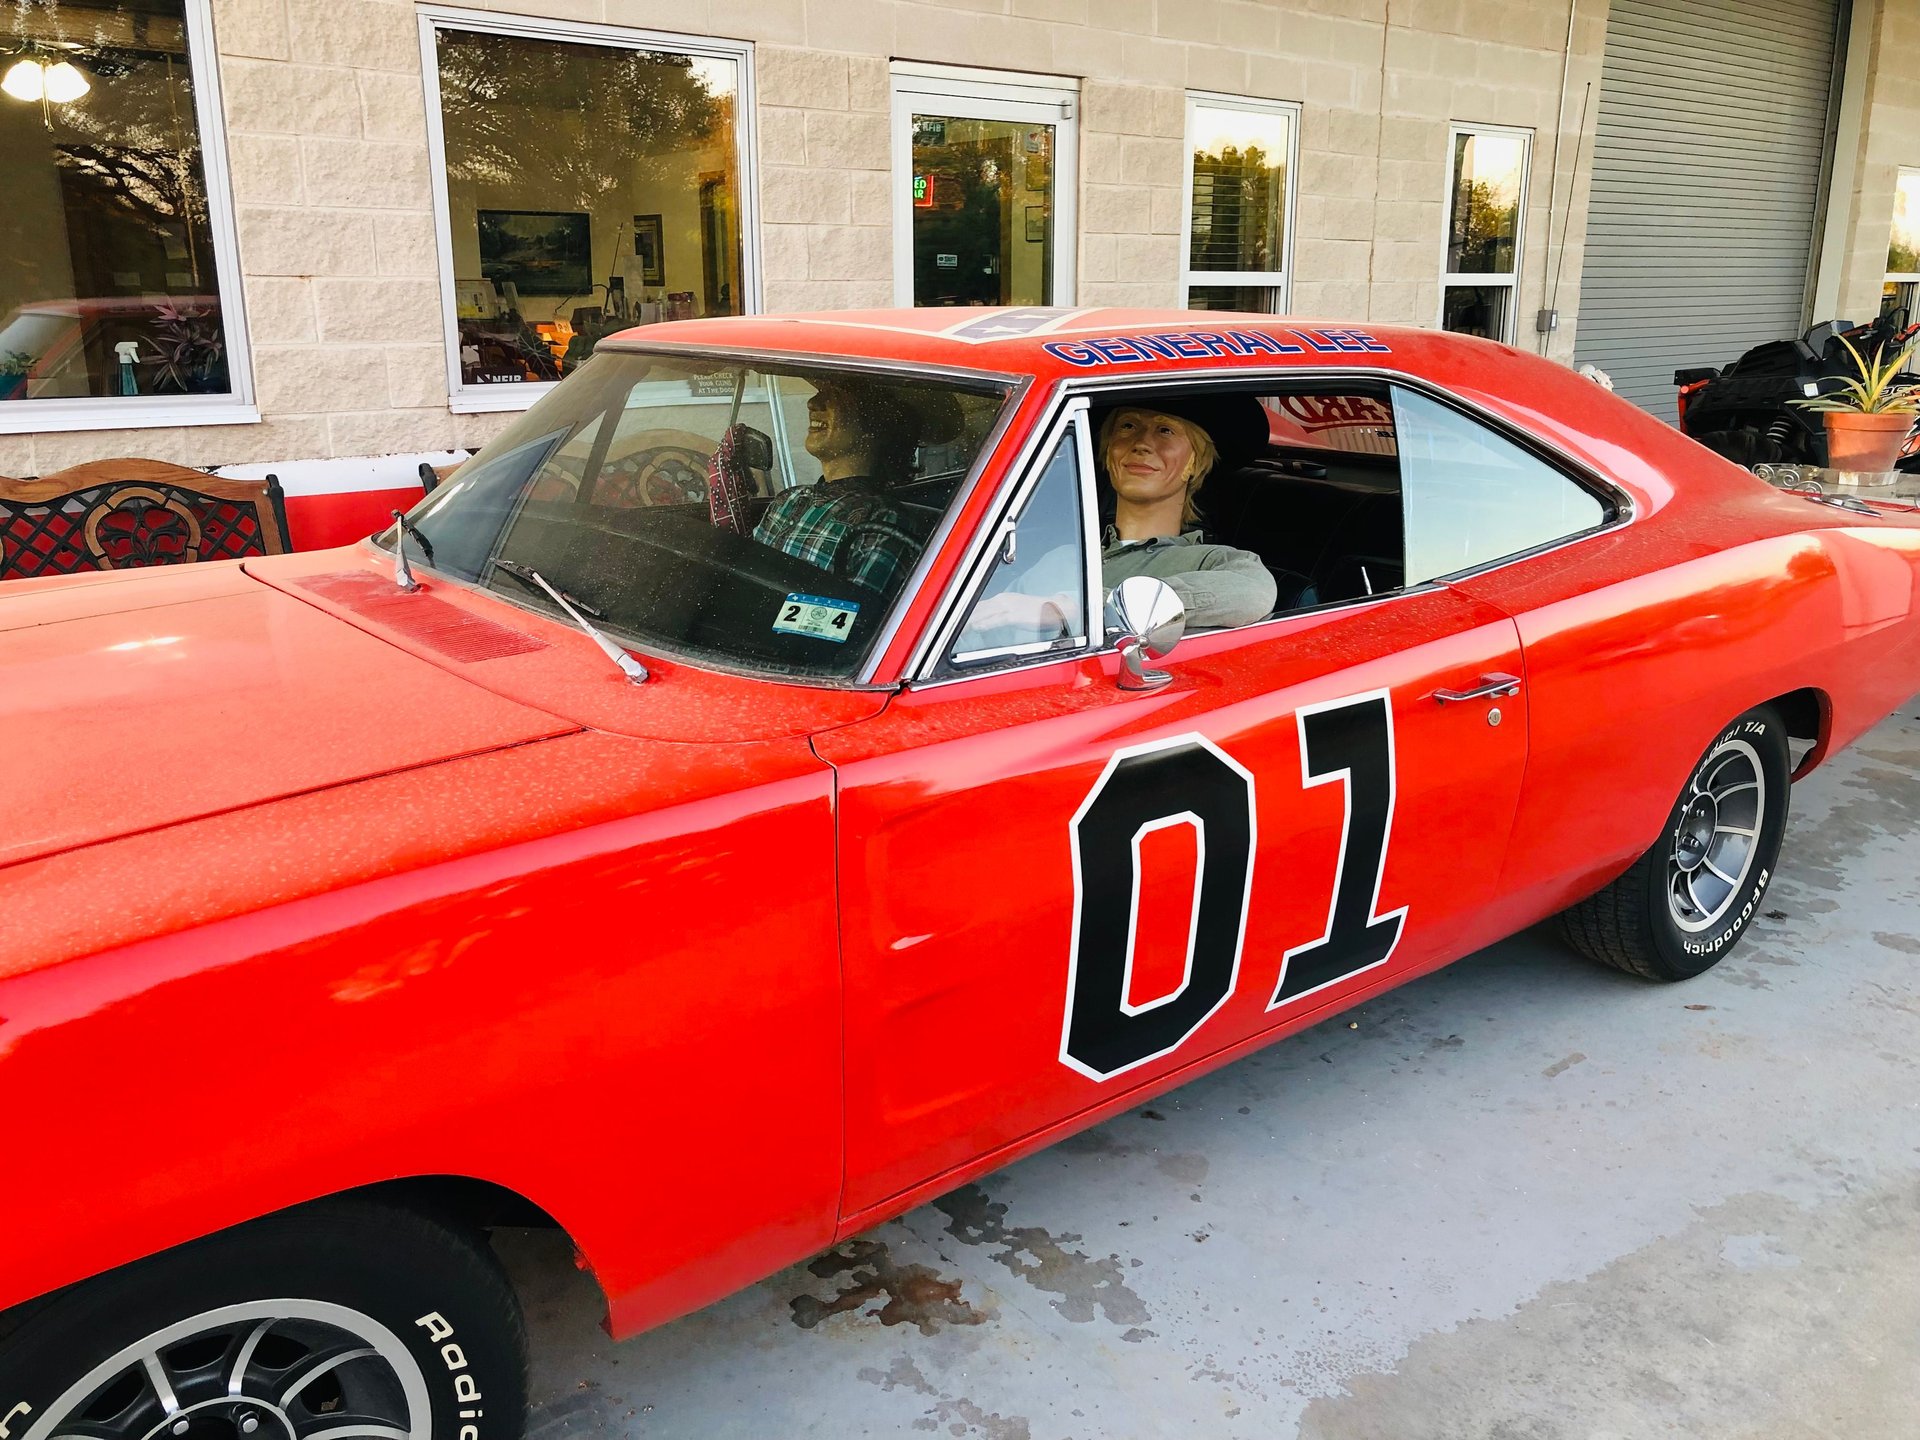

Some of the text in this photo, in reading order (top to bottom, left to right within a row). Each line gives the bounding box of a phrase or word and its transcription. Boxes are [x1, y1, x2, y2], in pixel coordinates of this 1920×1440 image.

[1043, 328, 1392, 367] GENERAL LEE
[783, 605, 802, 622] 2
[831, 612, 849, 629] 4
[1744, 721, 1767, 736] T/A
[1058, 687, 1409, 1083] 01
[1683, 868, 1769, 955] BFGoodrich
